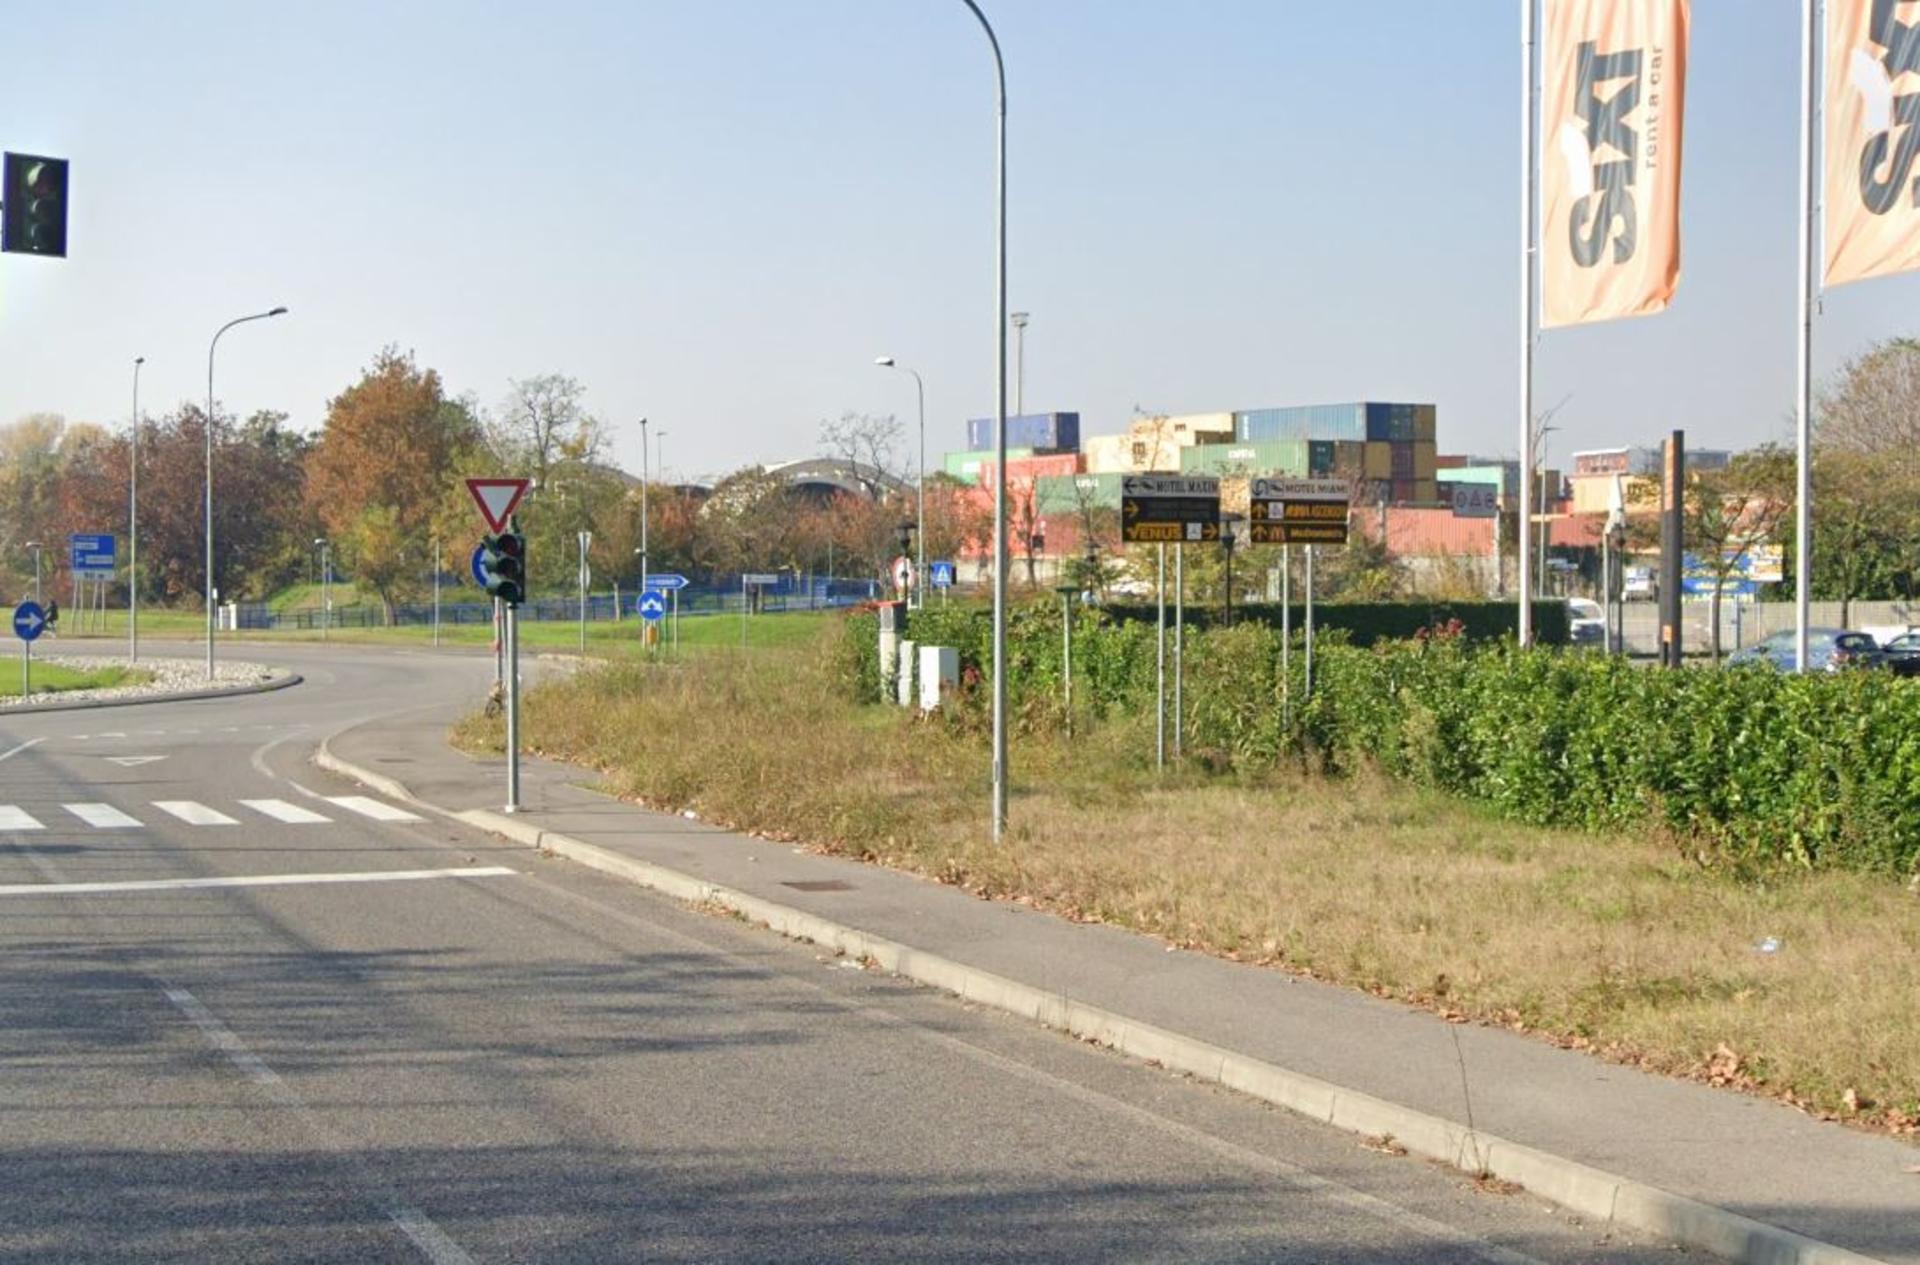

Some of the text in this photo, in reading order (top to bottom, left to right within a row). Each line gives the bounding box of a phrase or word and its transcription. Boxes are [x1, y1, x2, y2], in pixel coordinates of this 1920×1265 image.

[1645, 45, 1664, 170] rent a car
[1127, 522, 1182, 540] VENUS
